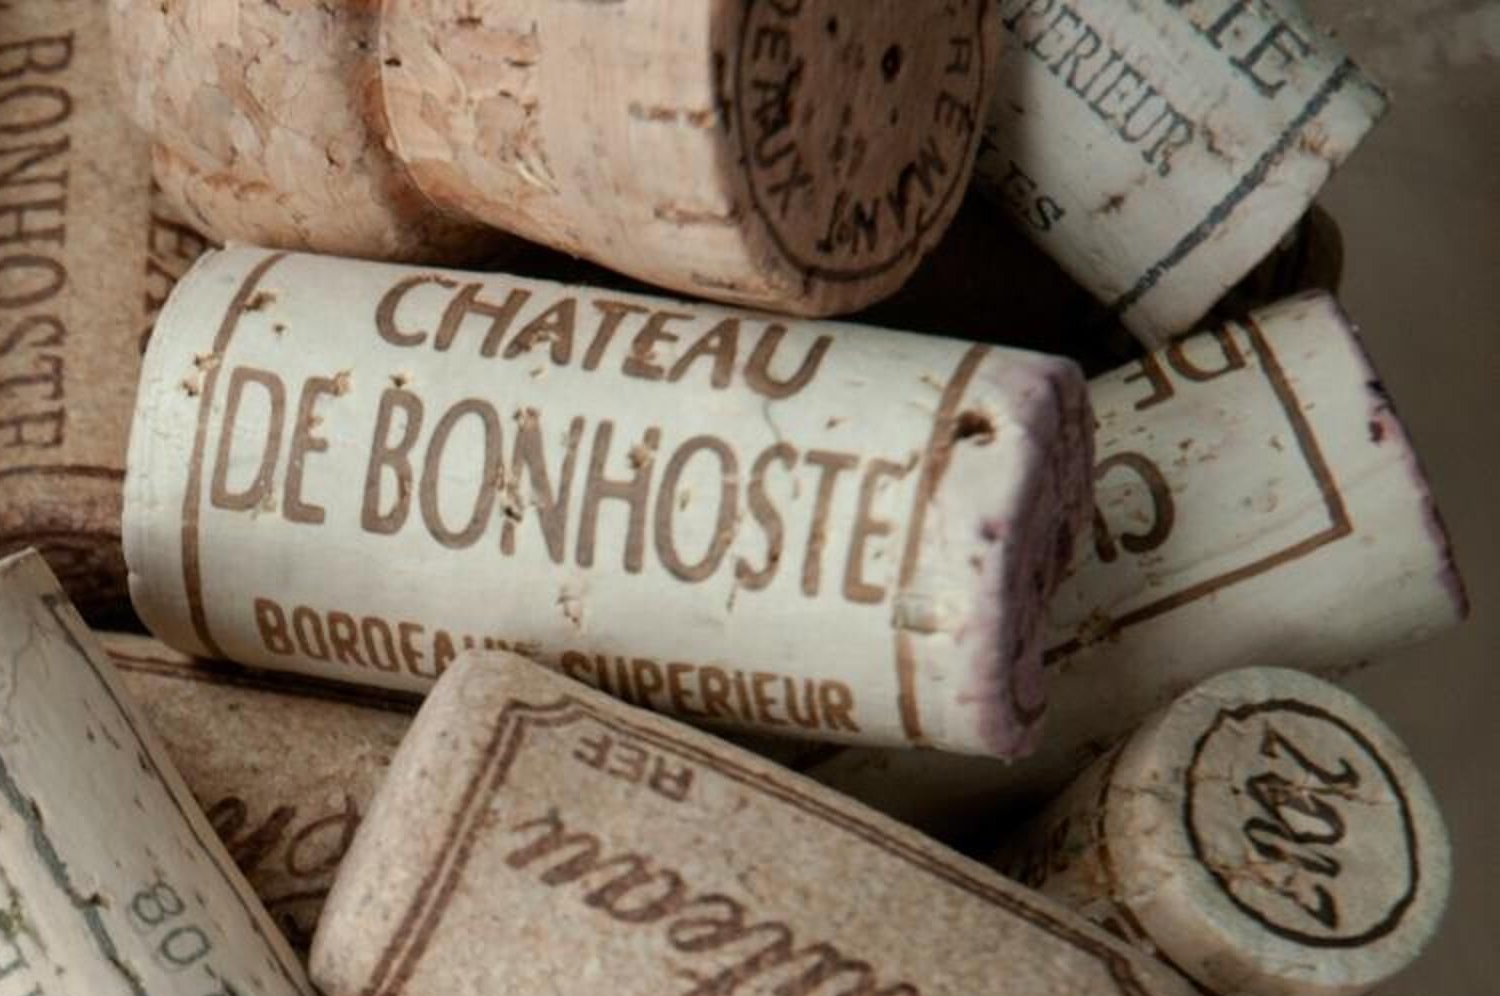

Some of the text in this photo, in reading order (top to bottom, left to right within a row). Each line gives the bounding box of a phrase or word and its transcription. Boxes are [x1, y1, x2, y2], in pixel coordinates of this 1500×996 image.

[1000, 0, 1198, 178] PERIEUR
[375, 273, 834, 400] CHATEAU
[210, 365, 351, 526] DE
[361, 385, 914, 606] BONHOSTE
[572, 733, 695, 802] REF
